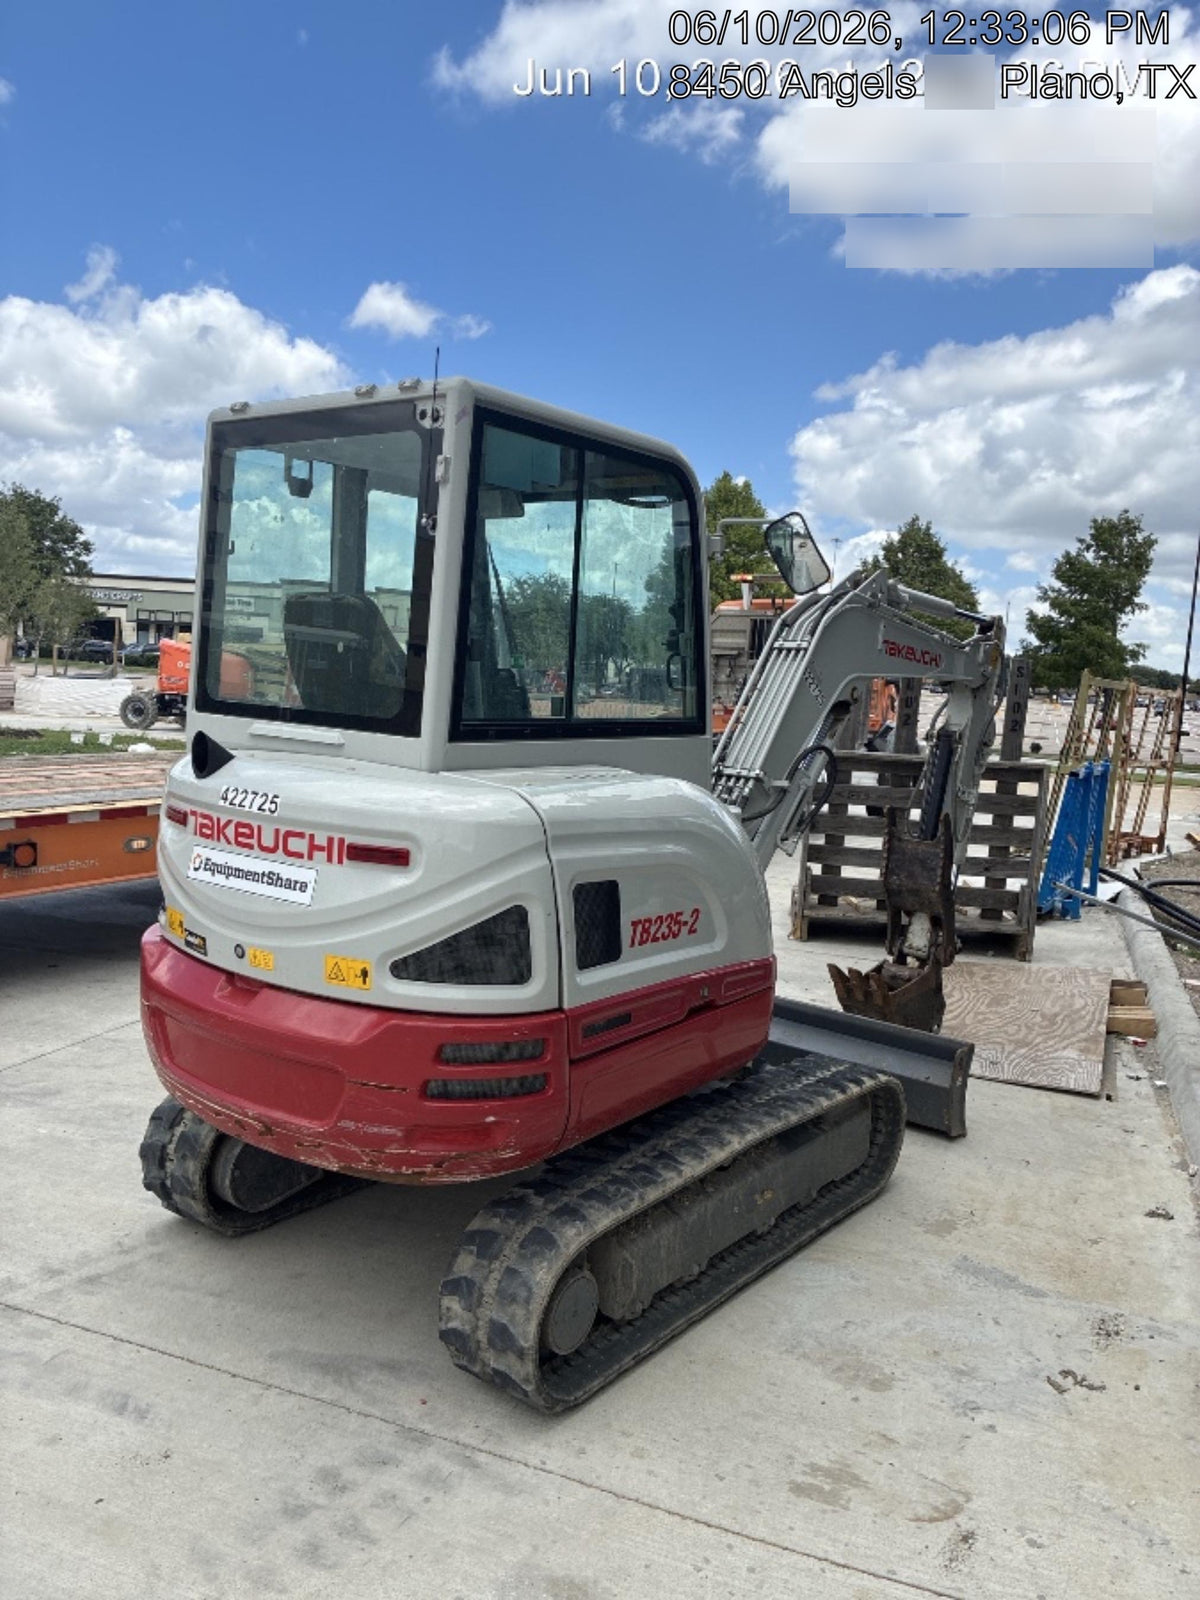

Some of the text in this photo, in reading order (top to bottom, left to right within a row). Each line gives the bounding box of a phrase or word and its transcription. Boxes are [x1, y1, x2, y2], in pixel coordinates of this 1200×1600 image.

[881, 639, 942, 668] TAKEUCHI
[220, 786, 280, 815] 422725
[189, 808, 346, 865] TAKEUCHI
[203, 857, 309, 893] EquipmentShare
[629, 907, 701, 948] TB235-2
